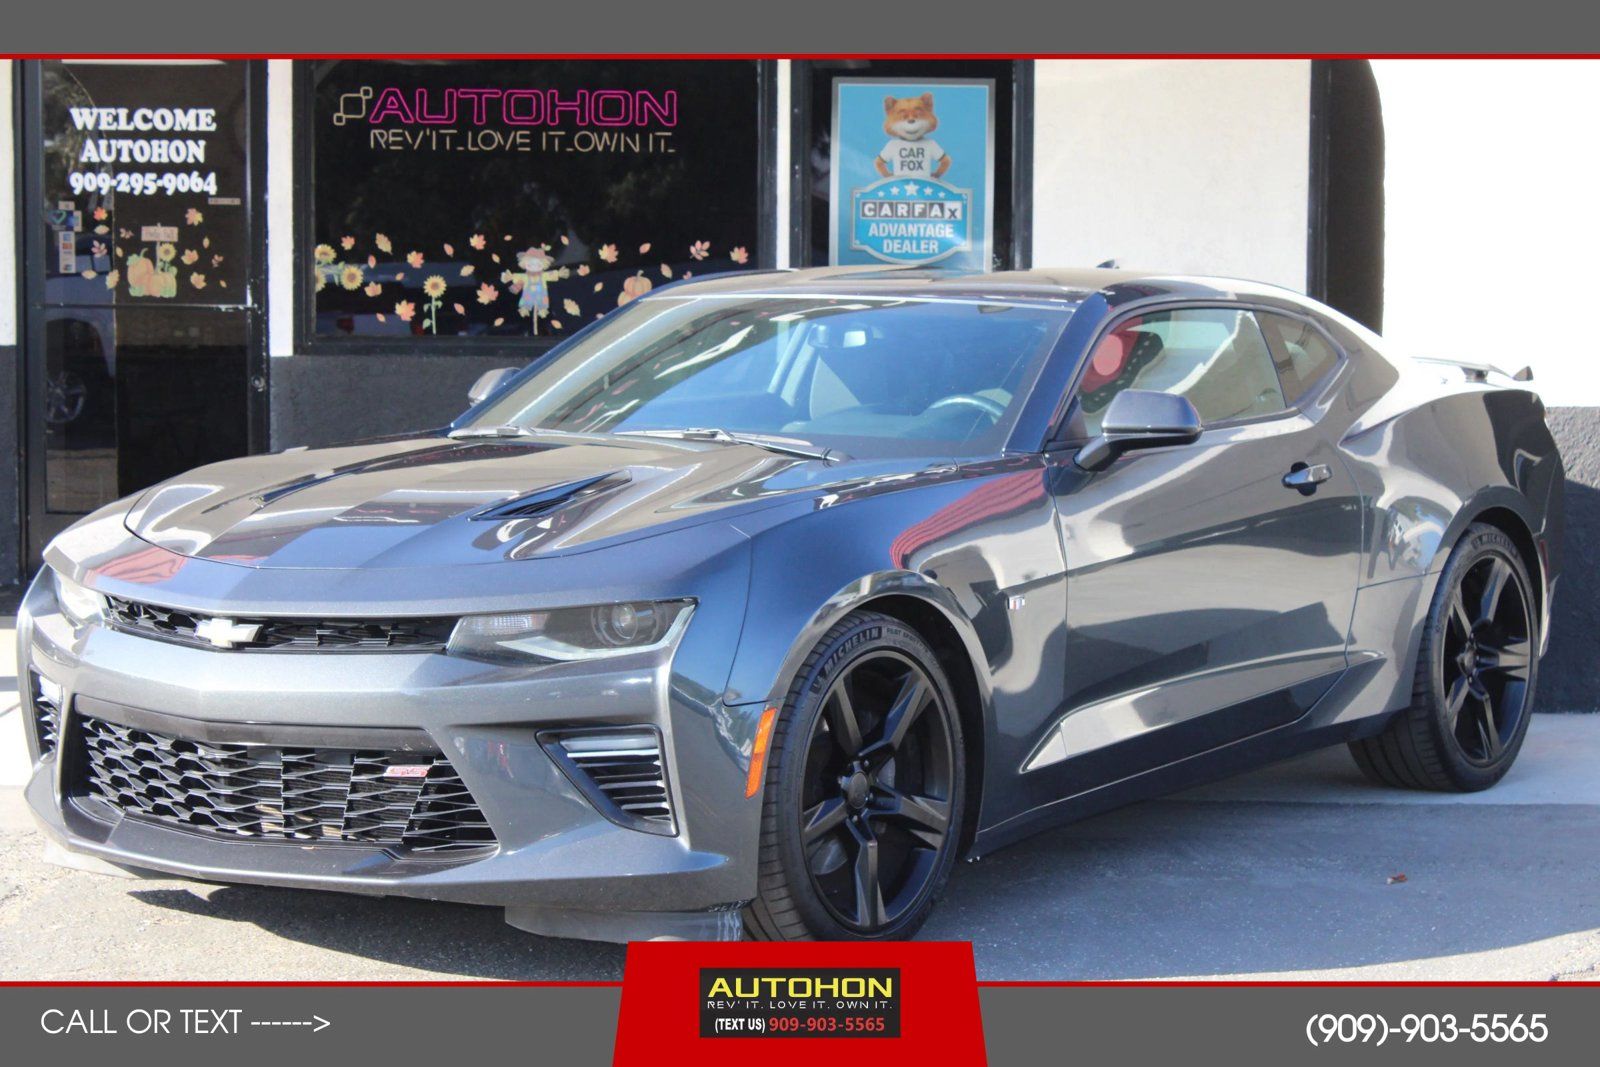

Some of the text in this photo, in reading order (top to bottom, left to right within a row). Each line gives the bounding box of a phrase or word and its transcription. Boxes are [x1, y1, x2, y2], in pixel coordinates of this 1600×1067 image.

[69, 107, 218, 132] WELCOME
[368, 88, 679, 128] AUTOHON
[79, 138, 207, 164] AUTOHON
[467, 130, 531, 152] LOVE
[574, 130, 640, 153] OWN
[899, 147, 925, 159] CAR
[900, 160, 924, 171] FOX
[69, 171, 218, 196] 909-295-9064
[868, 223, 955, 238] ADVANTAGE
[883, 239, 939, 254] DEALER
[823, 626, 881, 675] MICHELIN
